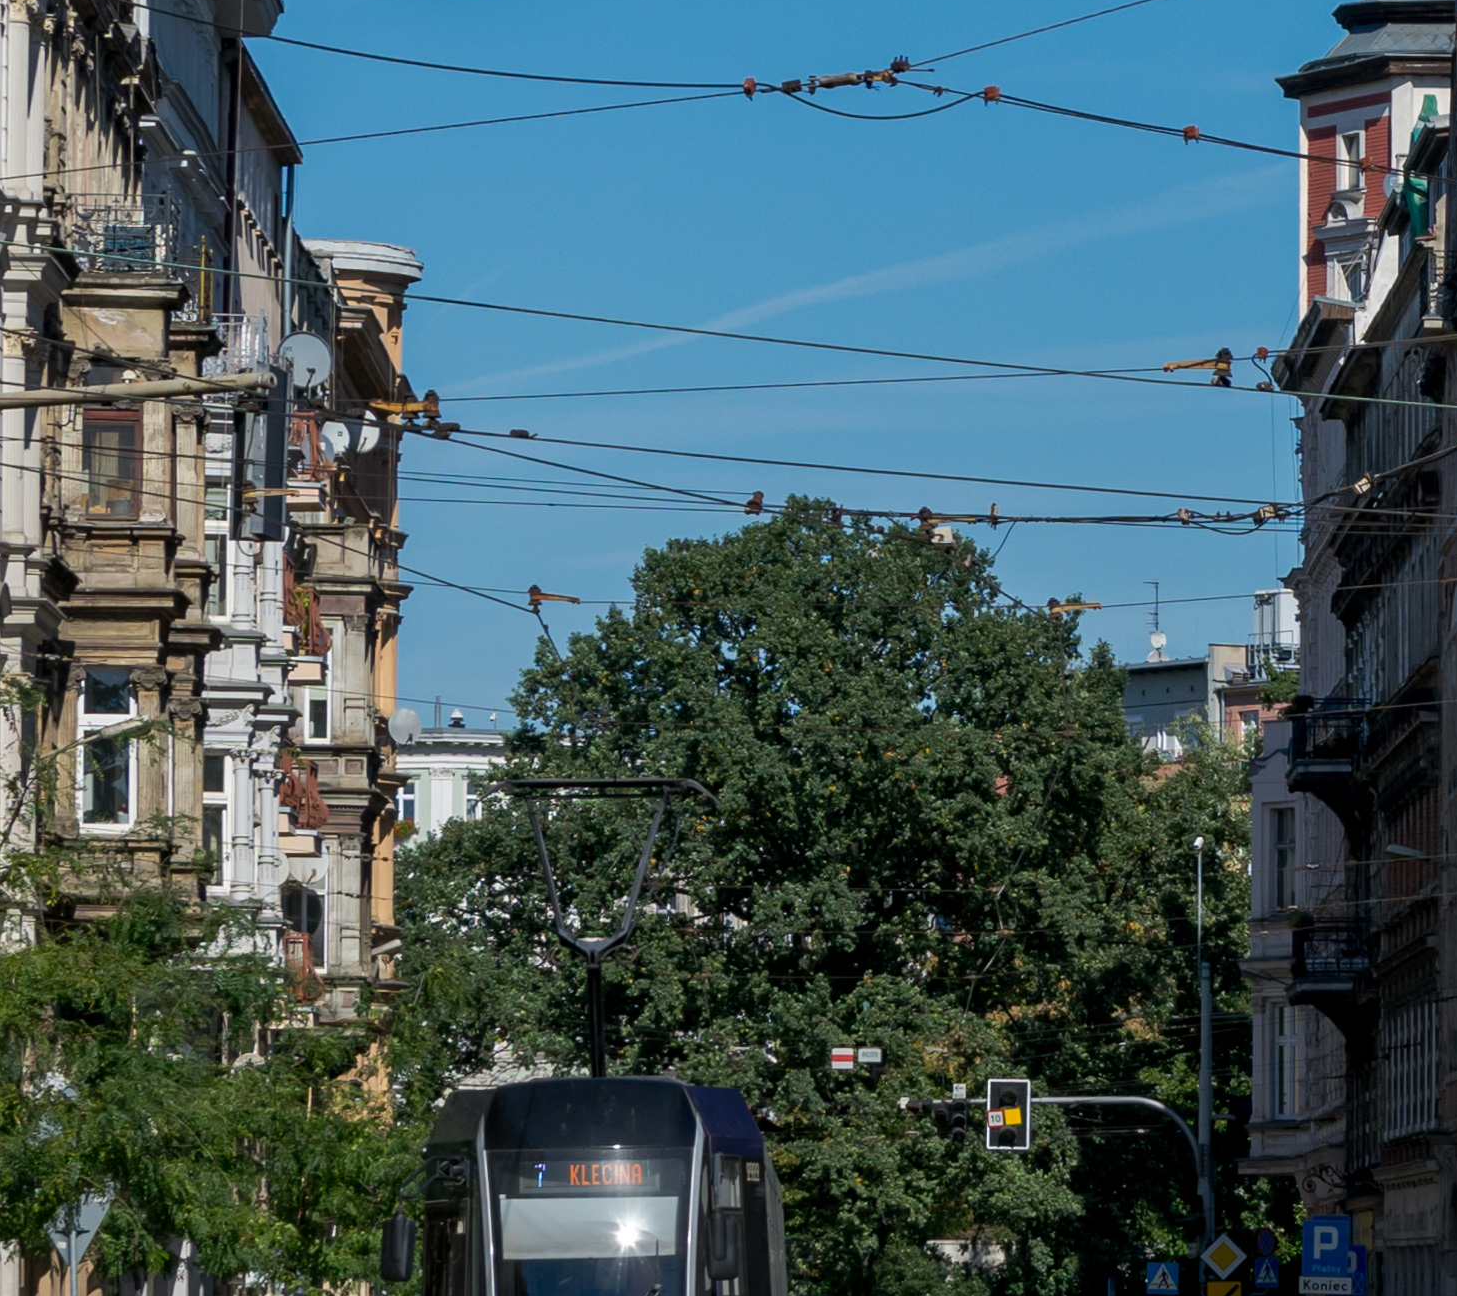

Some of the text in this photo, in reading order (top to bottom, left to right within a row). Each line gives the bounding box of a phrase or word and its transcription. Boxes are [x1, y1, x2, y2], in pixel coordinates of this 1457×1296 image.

[990, 1114, 1001, 1124] 10
[569, 1163, 643, 1186] KLECINA
[1313, 1226, 1339, 1259] P
[1303, 1279, 1348, 1292] Koniec
